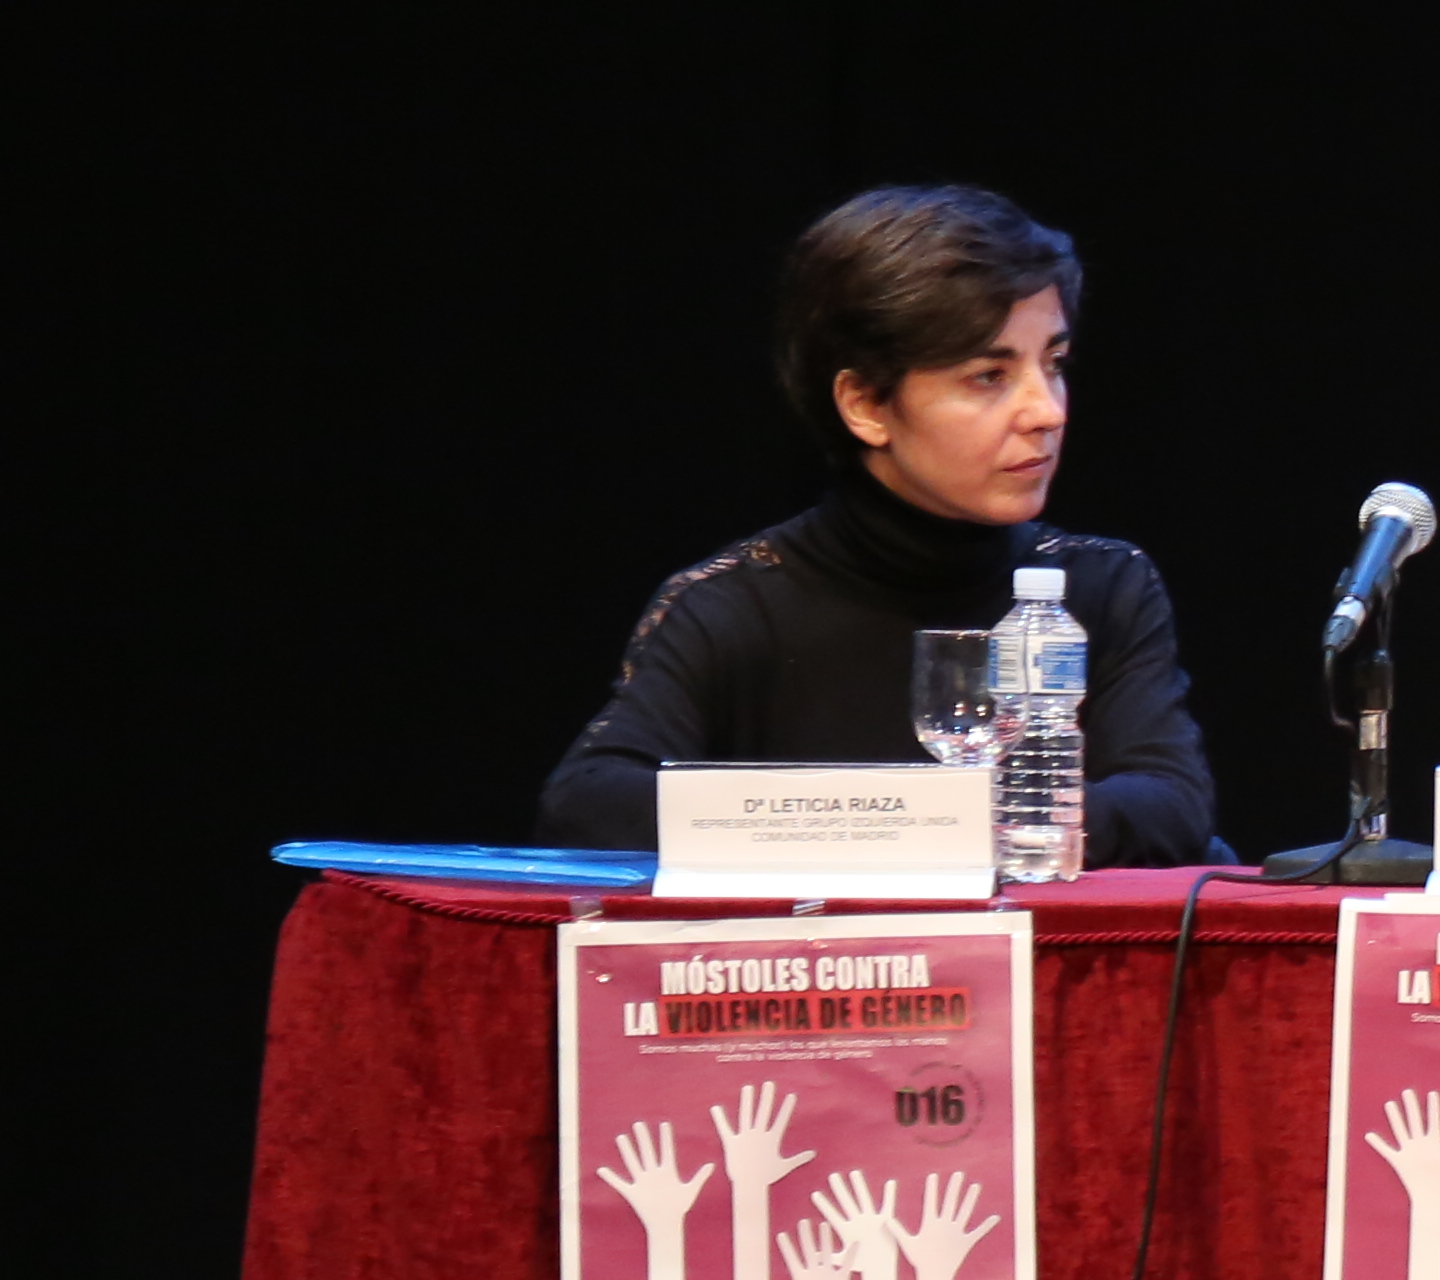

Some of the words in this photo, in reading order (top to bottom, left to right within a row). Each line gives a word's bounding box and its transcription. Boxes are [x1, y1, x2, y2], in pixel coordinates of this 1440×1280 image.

[770, 798, 843, 813] LETICIA
[848, 797, 906, 813] RIAZA
[660, 955, 810, 995] MÓSTOLES
[815, 954, 931, 990] CONTRA
[1398, 969, 1431, 1004] LA
[623, 1002, 659, 1037] LA
[664, 998, 810, 1034] VIOLENCIA
[819, 995, 852, 1029] DE
[861, 989, 967, 1028] GÉNERO
